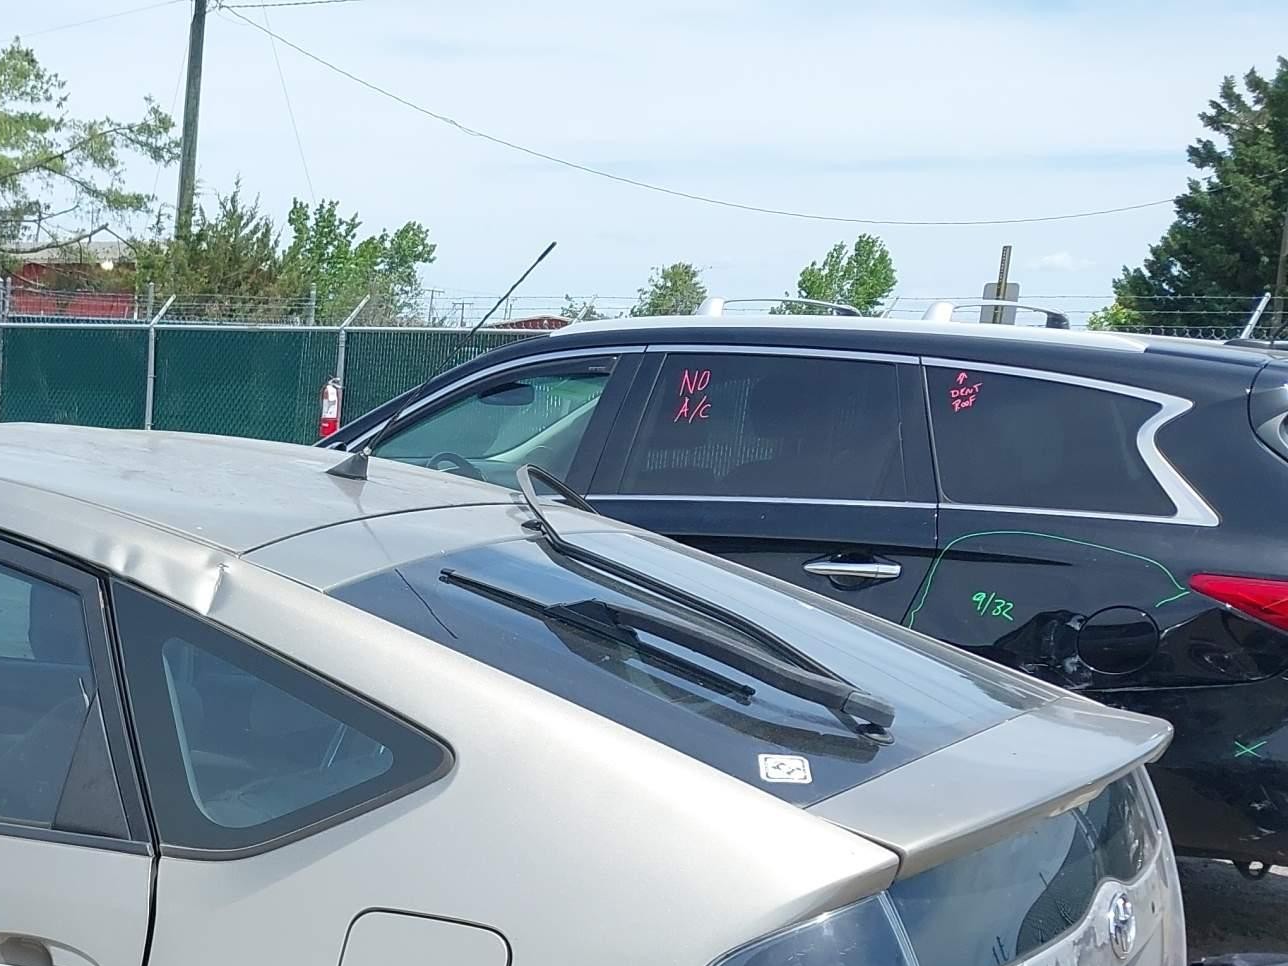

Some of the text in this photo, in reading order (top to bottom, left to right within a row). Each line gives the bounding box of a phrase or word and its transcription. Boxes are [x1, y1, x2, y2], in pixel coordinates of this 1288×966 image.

[679, 370, 710, 396] NO
[950, 383, 983, 398] DENT
[674, 396, 711, 424] A/C
[952, 395, 976, 412] ROOF
[972, 592, 1013, 621] 9/32
